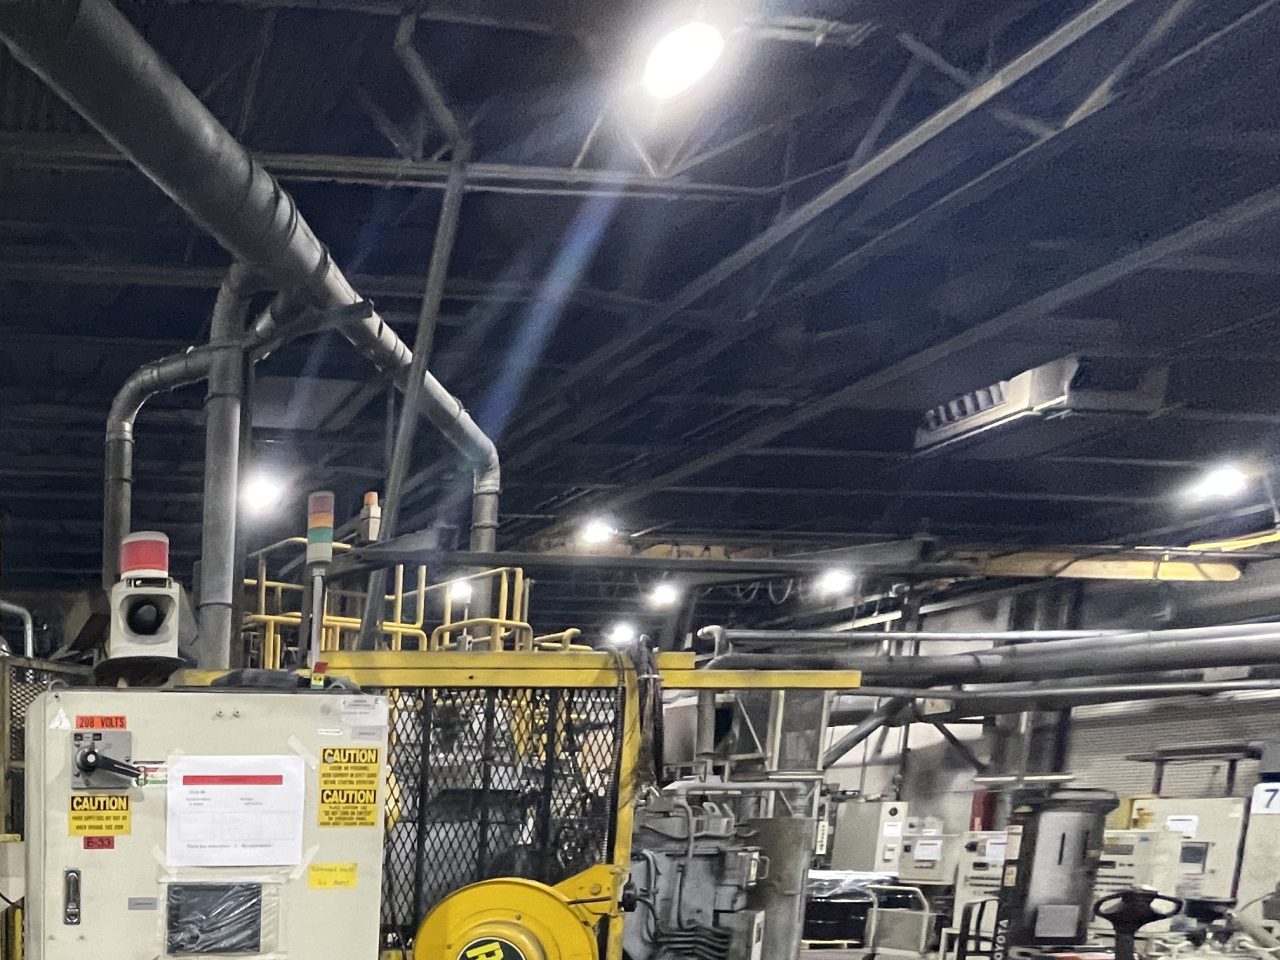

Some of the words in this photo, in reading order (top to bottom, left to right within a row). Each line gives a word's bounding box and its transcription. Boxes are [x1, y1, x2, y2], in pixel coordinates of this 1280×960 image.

[79, 716, 95, 728] 208
[100, 716, 125, 728] VOLTS
[324, 749, 377, 763] CAUTION
[72, 796, 127, 811] CAUTION
[322, 790, 375, 804] CAUTION
[1264, 788, 1279, 809] 7
